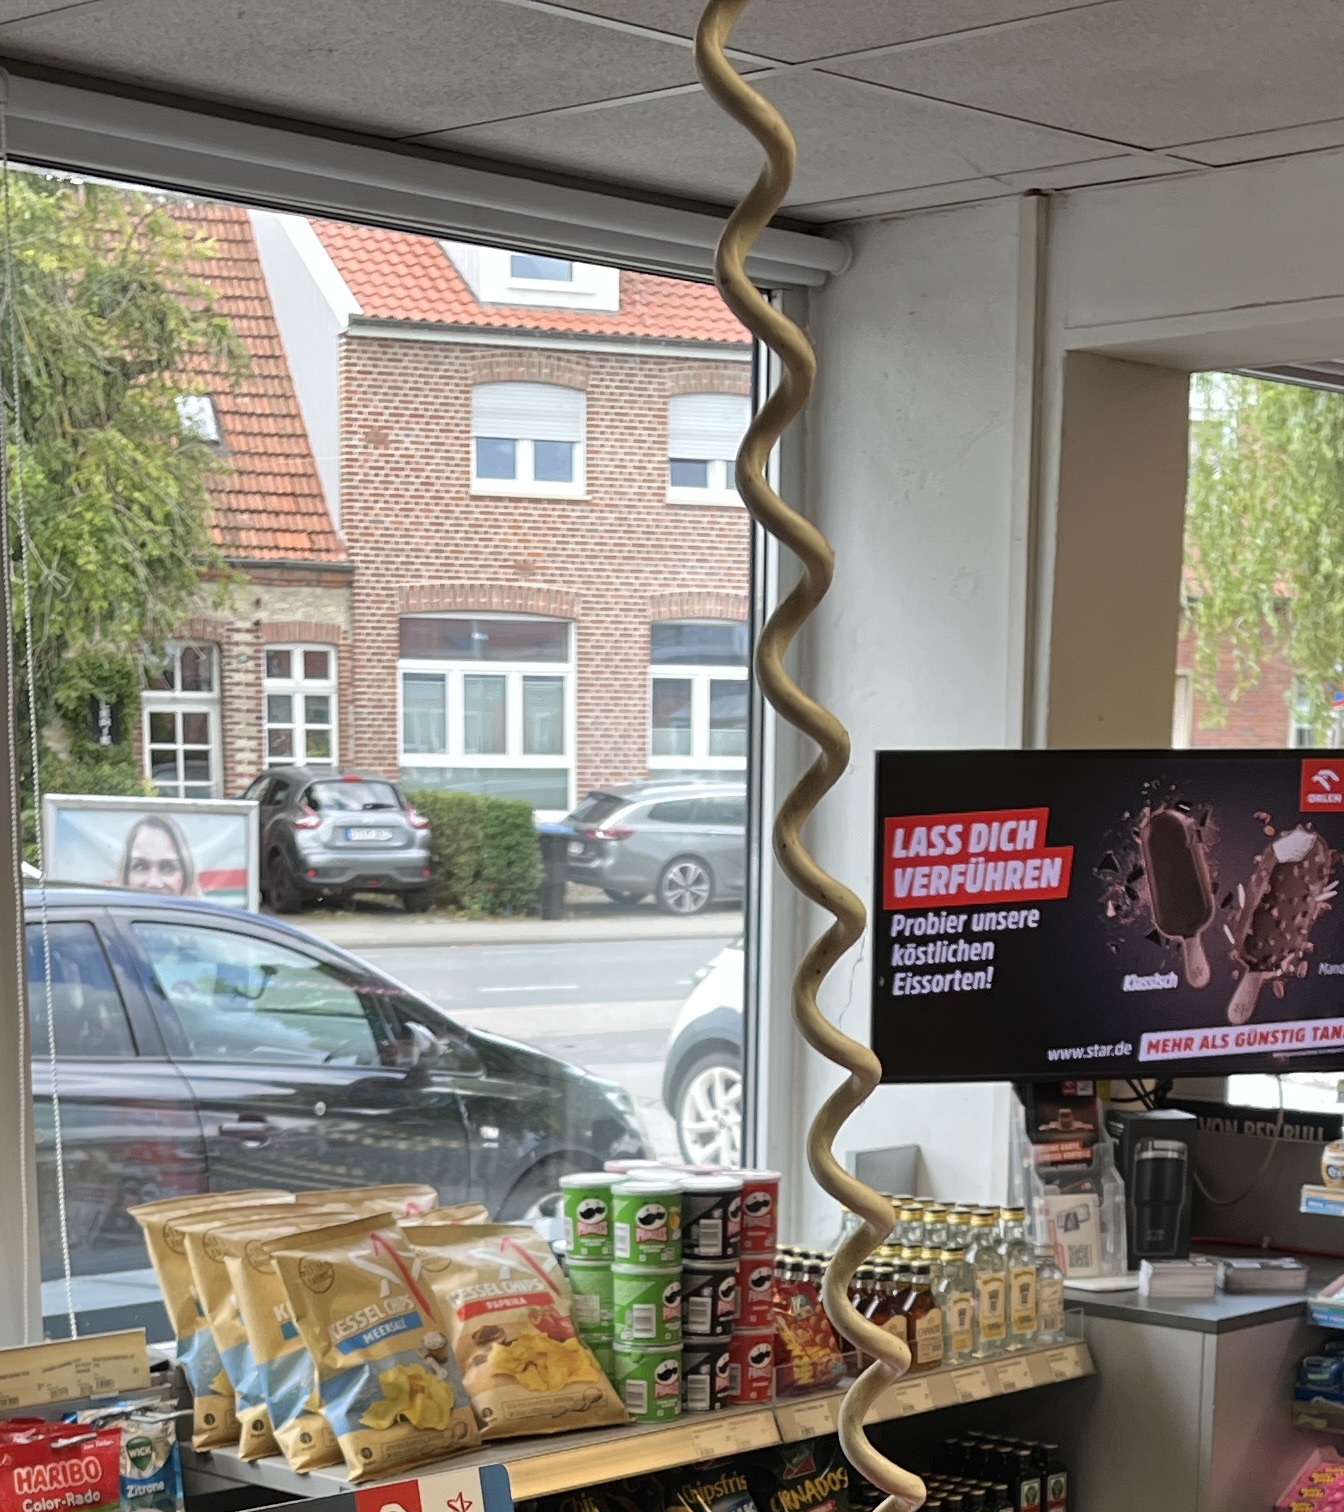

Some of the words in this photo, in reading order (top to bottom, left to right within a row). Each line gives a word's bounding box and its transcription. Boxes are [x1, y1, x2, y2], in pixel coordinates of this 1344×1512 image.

[892, 826, 962, 859] LASS
[966, 820, 1039, 853] DICH
[892, 856, 1065, 898] VERFÜHREN
[890, 912, 967, 939] Probier
[971, 908, 1041, 933] unsere
[891, 940, 995, 967] köstlichen
[891, 967, 994, 996] Eissorten!
[1046, 1040, 1133, 1063] www.star.de
[1146, 1035, 1196, 1057] MEHR
[1199, 1032, 1231, 1052] ALS
[1235, 1025, 1307, 1048] GÜNSTIG
[503, 1277, 546, 1294] CHIPS
[329, 1304, 386, 1341] KESSEL
[363, 1317, 408, 1345] MEERSALZ
[14, 1457, 102, 1495] HARIBO
[125, 1480, 166, 1498] Zitrone
